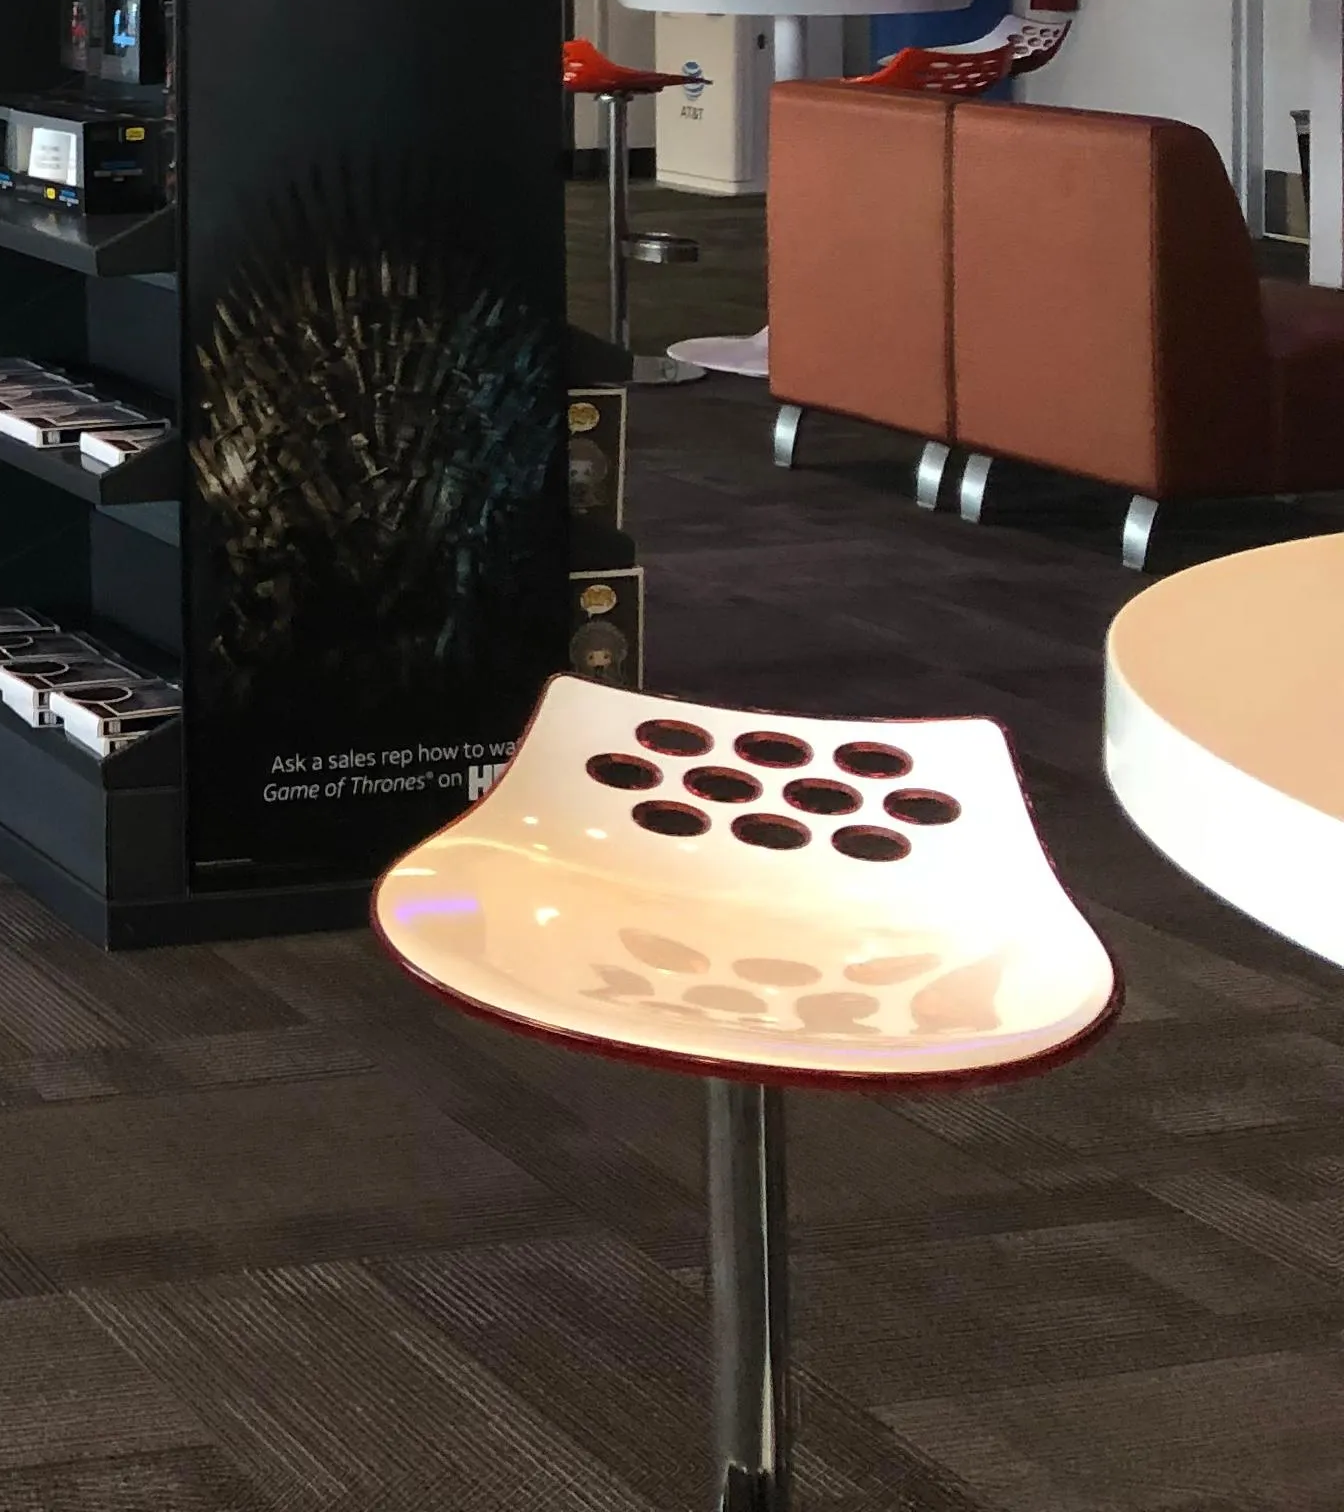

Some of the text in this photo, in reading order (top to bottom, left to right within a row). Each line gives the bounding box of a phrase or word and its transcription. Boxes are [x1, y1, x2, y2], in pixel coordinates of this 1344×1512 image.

[271, 755, 306, 774] Ask
[312, 756, 323, 771] a
[328, 749, 374, 770] sales
[381, 747, 413, 769] rep
[418, 743, 459, 763] how
[463, 742, 485, 760] to
[263, 781, 320, 803] Game
[324, 775, 346, 799] of
[438, 772, 462, 789] on
